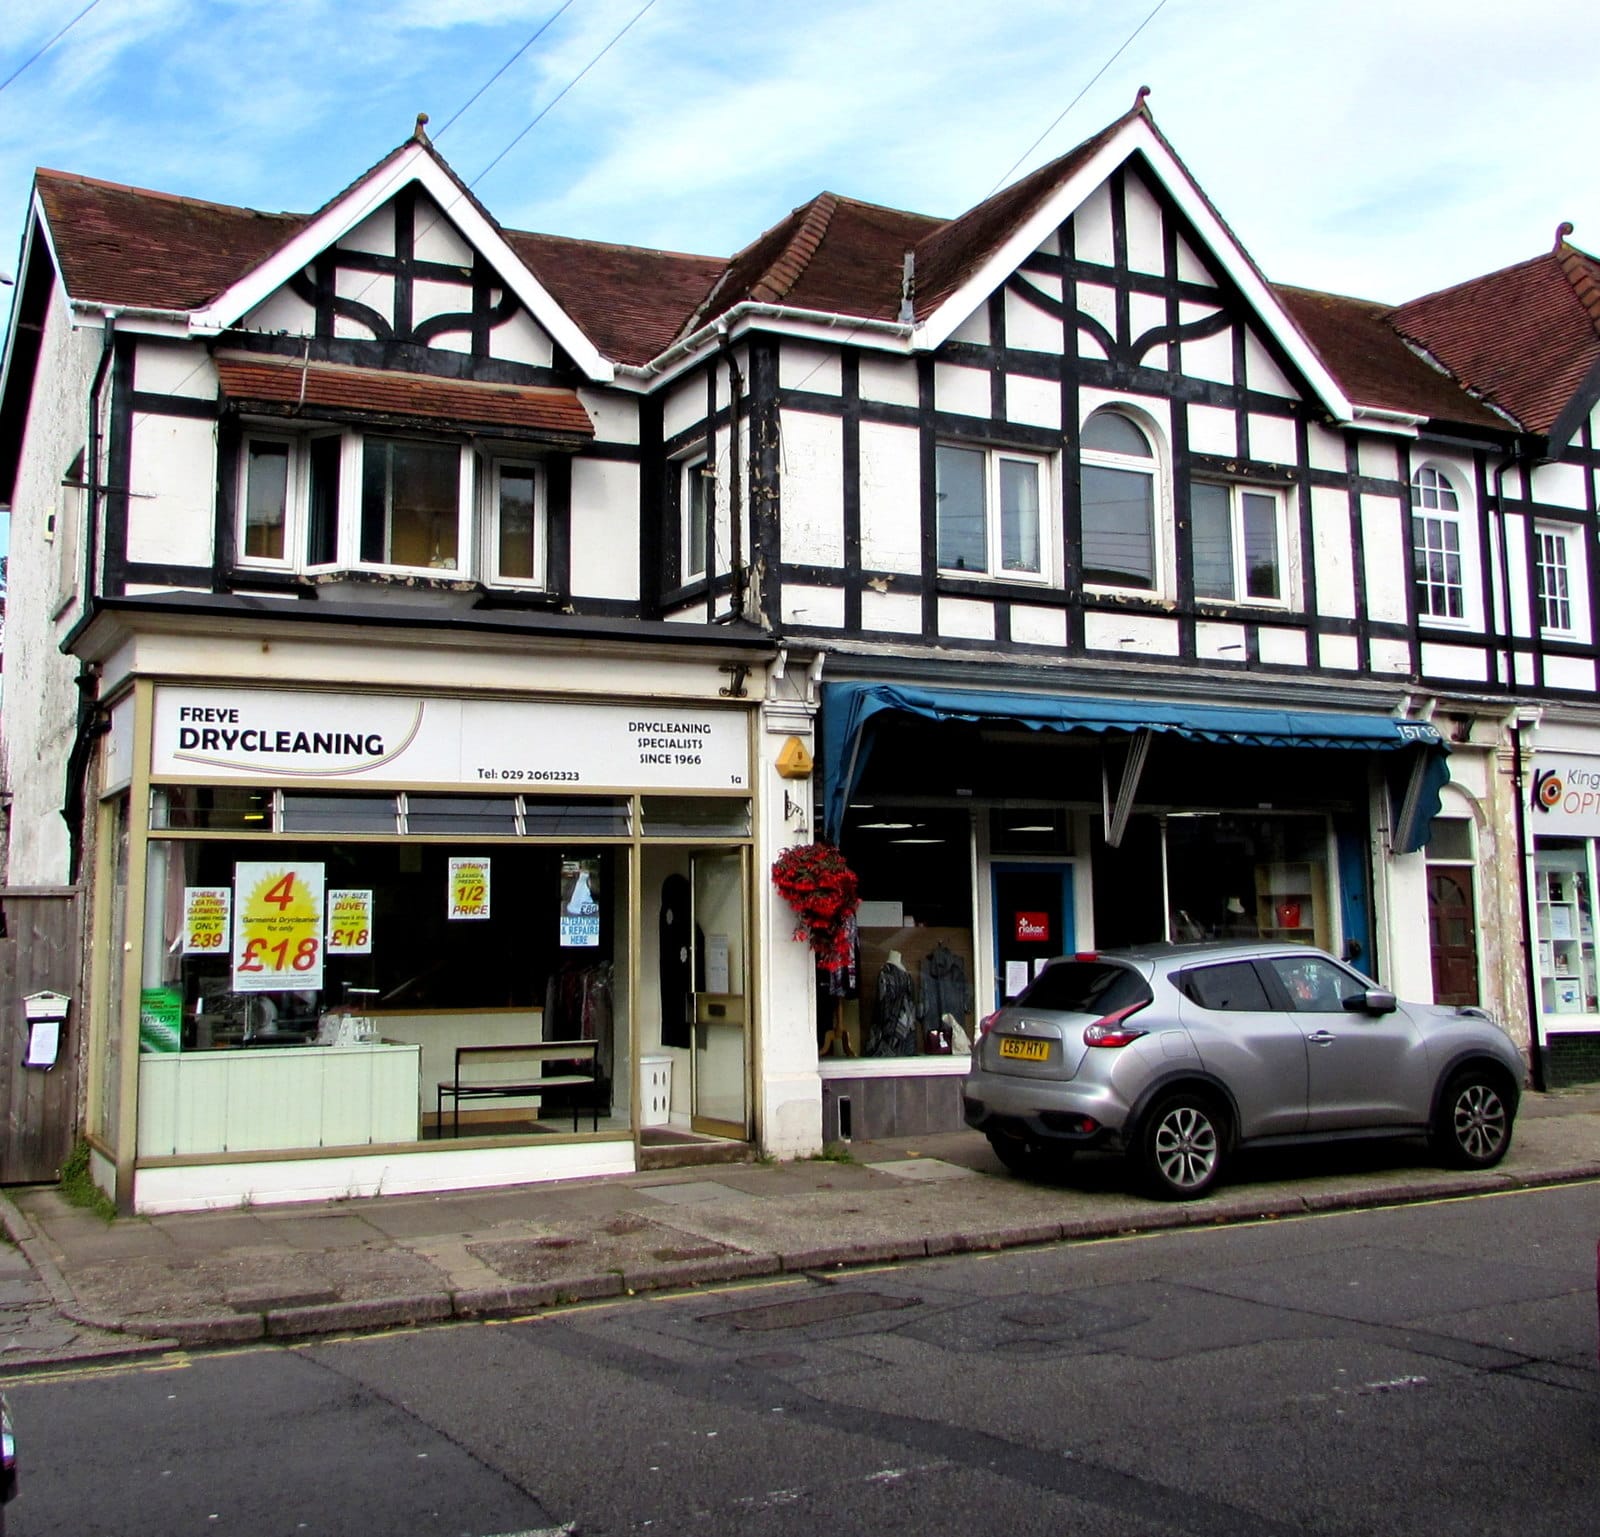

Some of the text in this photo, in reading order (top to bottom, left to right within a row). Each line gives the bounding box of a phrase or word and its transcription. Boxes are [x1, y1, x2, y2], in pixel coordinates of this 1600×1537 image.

[179, 706, 240, 724] FREYE
[628, 721, 712, 734] DRYCLEANING
[179, 727, 385, 755] DRYCLEANING
[637, 738, 703, 750] SPECIALISTS
[639, 753, 702, 765] SINCE 1966
[477, 768, 580, 781] Tel: 029 20612323
[730, 774, 742, 785] 1a
[263, 871, 296, 911] 4
[332, 892, 369, 900] ANY SIZE
[457, 885, 484, 902] 1/2
[334, 901, 368, 911] DUVET
[452, 904, 489, 915] PRICE
[195, 922, 220, 930] ONLY
[188, 932, 223, 948] £39
[329, 928, 369, 946] £18
[570, 935, 588, 945] HERE
[236, 937, 319, 973] £18
[1002, 1038, 1026, 1055] CE67
